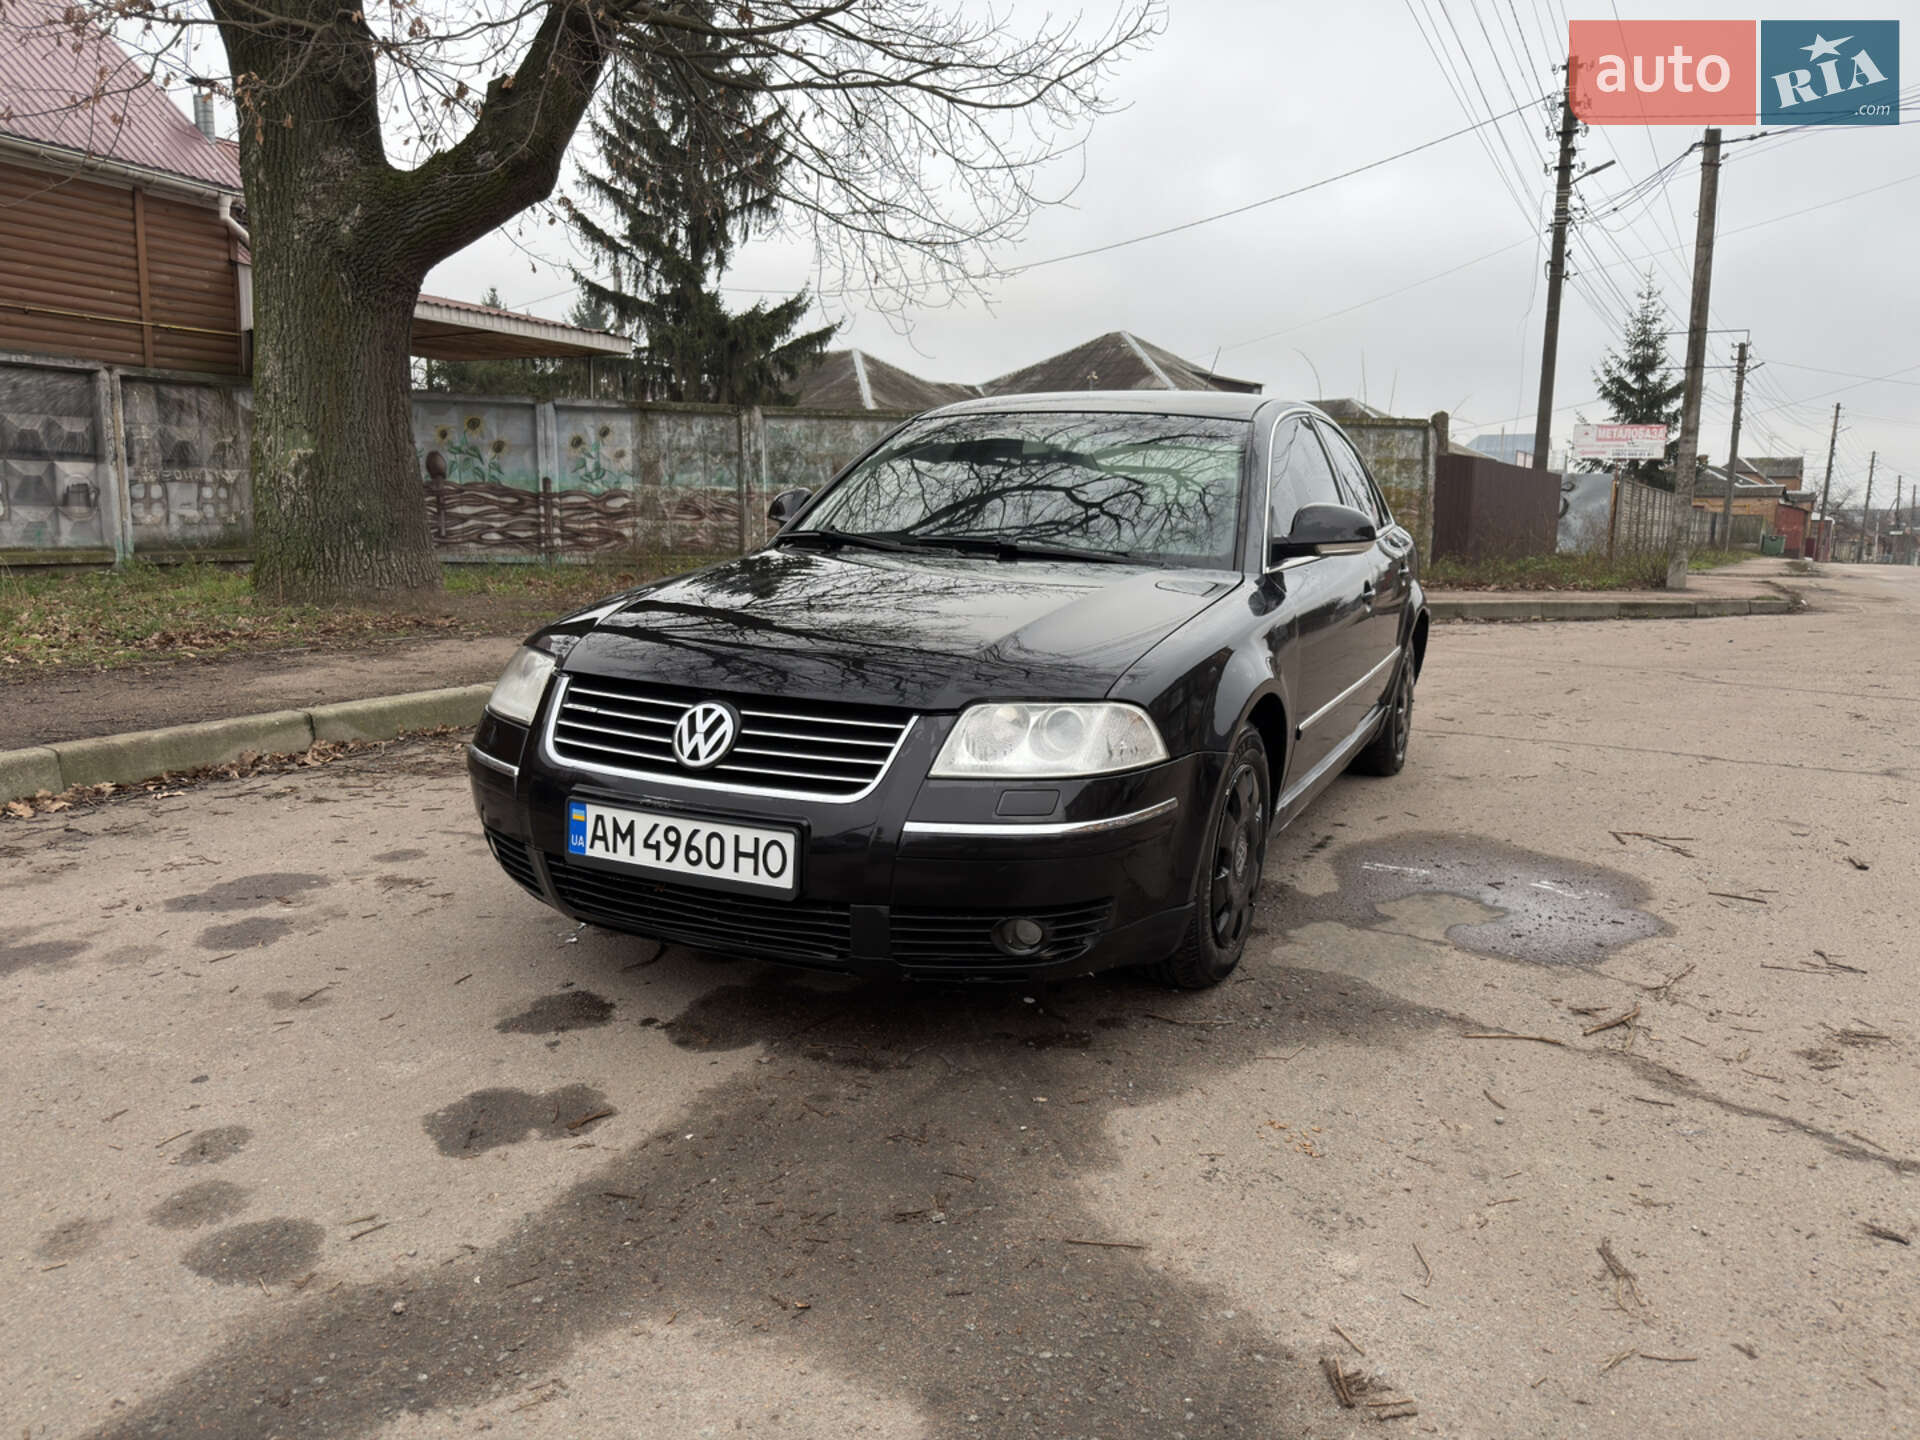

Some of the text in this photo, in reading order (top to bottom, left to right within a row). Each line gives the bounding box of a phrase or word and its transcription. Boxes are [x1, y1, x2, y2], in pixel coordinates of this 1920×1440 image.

[571, 834, 584, 847] UA
[589, 814, 787, 879] AM 4960 HO
